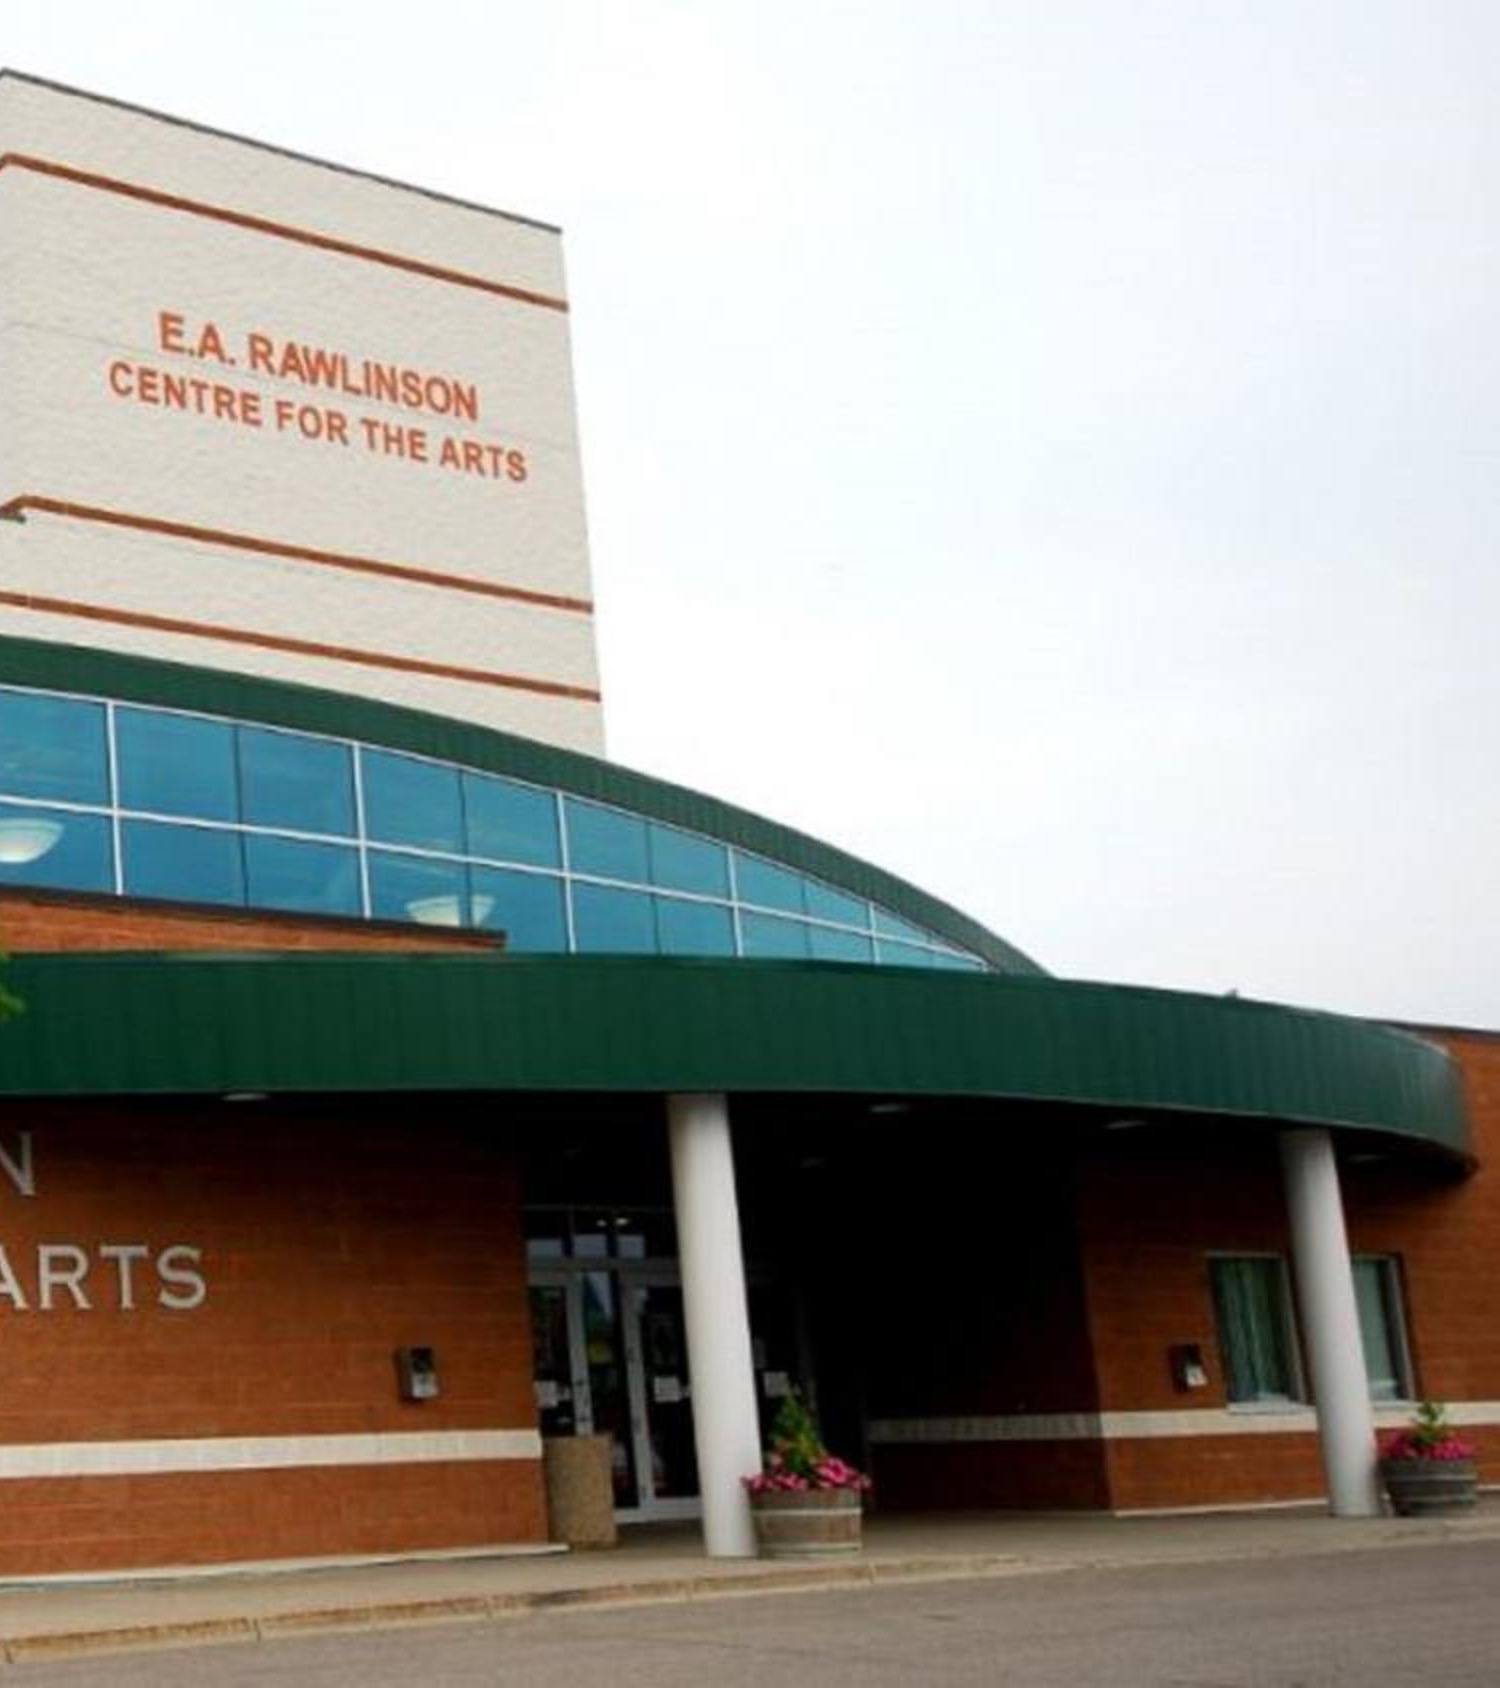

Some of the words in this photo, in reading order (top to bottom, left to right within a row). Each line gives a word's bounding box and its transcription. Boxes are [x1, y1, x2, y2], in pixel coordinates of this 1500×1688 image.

[108, 361, 263, 426] CENTRE
[275, 400, 350, 446] FOR
[360, 417, 429, 462] THE
[438, 437, 529, 483] ARTS
[159, 311, 236, 366] E.A.
[248, 332, 479, 421] RAWLINSON
